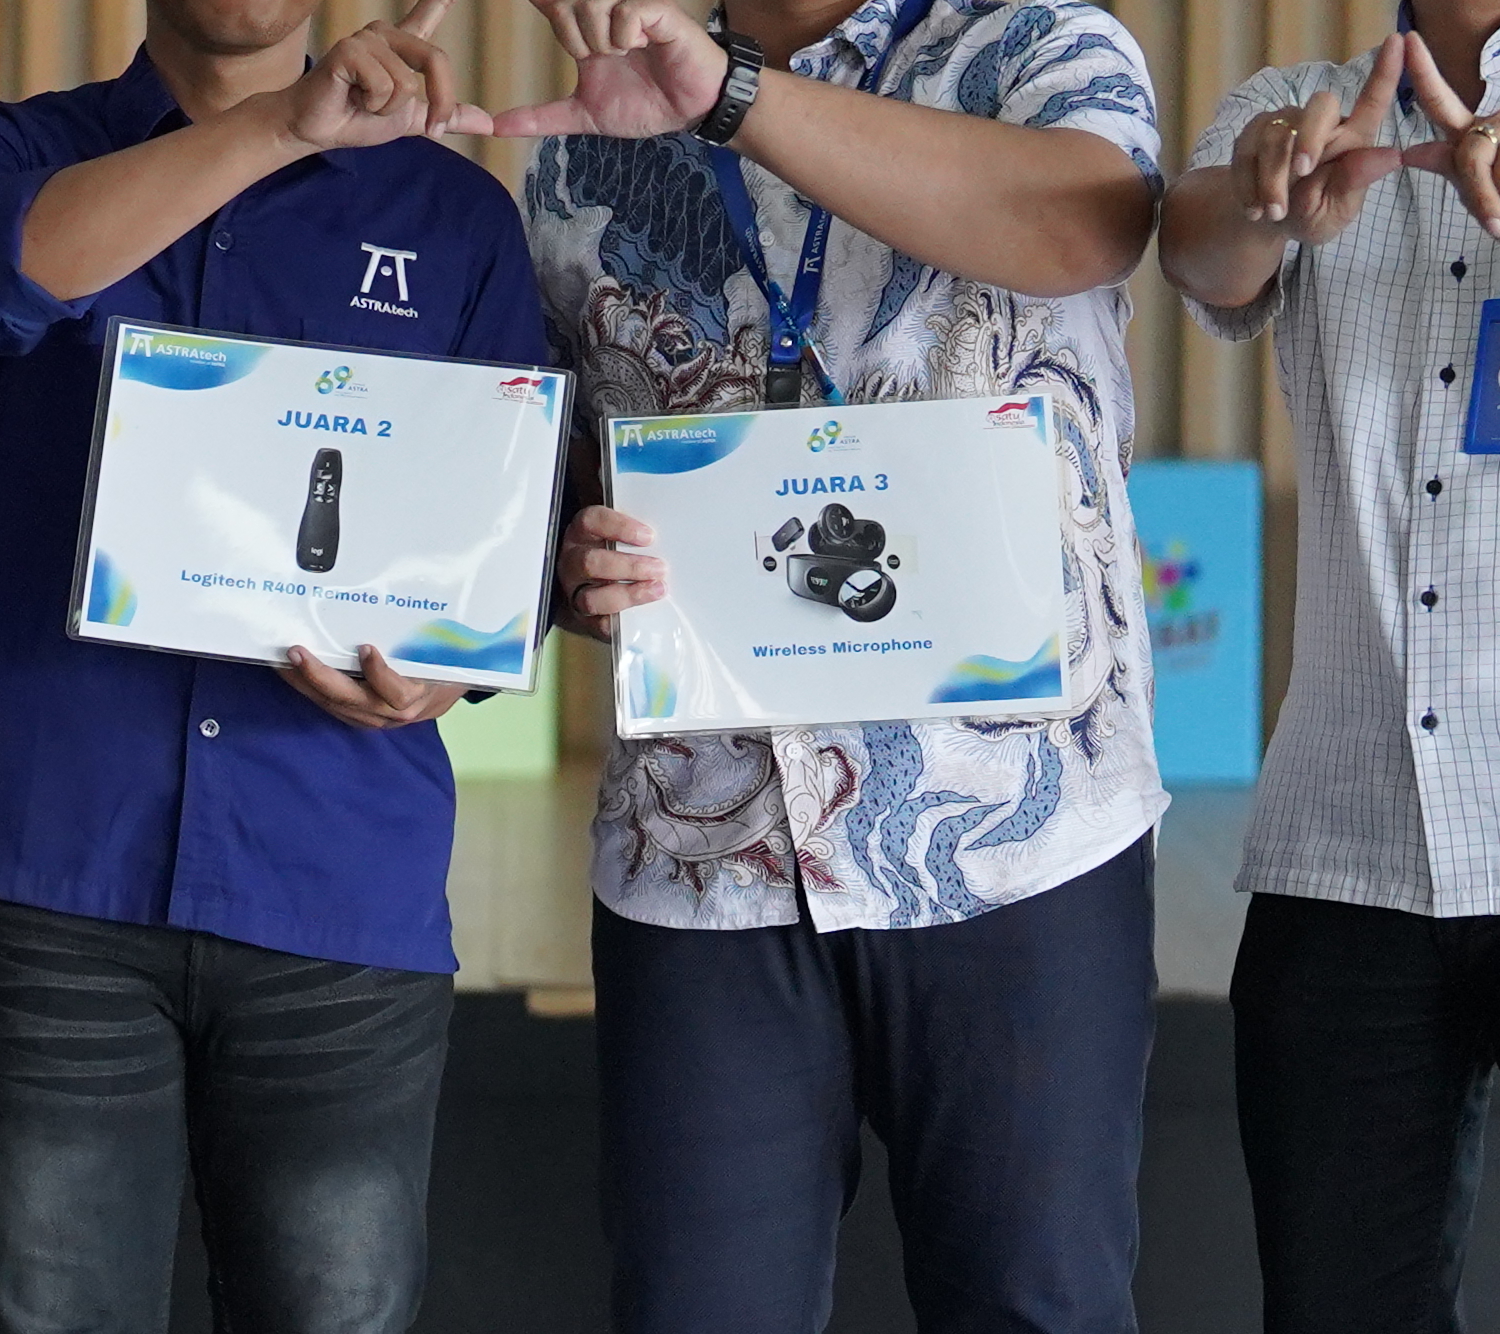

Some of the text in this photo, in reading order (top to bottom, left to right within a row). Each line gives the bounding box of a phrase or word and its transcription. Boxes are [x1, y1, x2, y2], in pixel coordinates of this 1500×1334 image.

[350, 296, 418, 318] ASTRAtech
[156, 344, 227, 362] ASTRAtech
[315, 366, 353, 394] 69
[278, 410, 392, 437] JUARA 2
[647, 428, 717, 441] ASTRAtech
[807, 420, 842, 452] 69
[775, 473, 889, 496] JUARA 3
[181, 570, 448, 612] Logitech R400 Remote Pointer
[753, 638, 933, 657] Wireless Microphone
